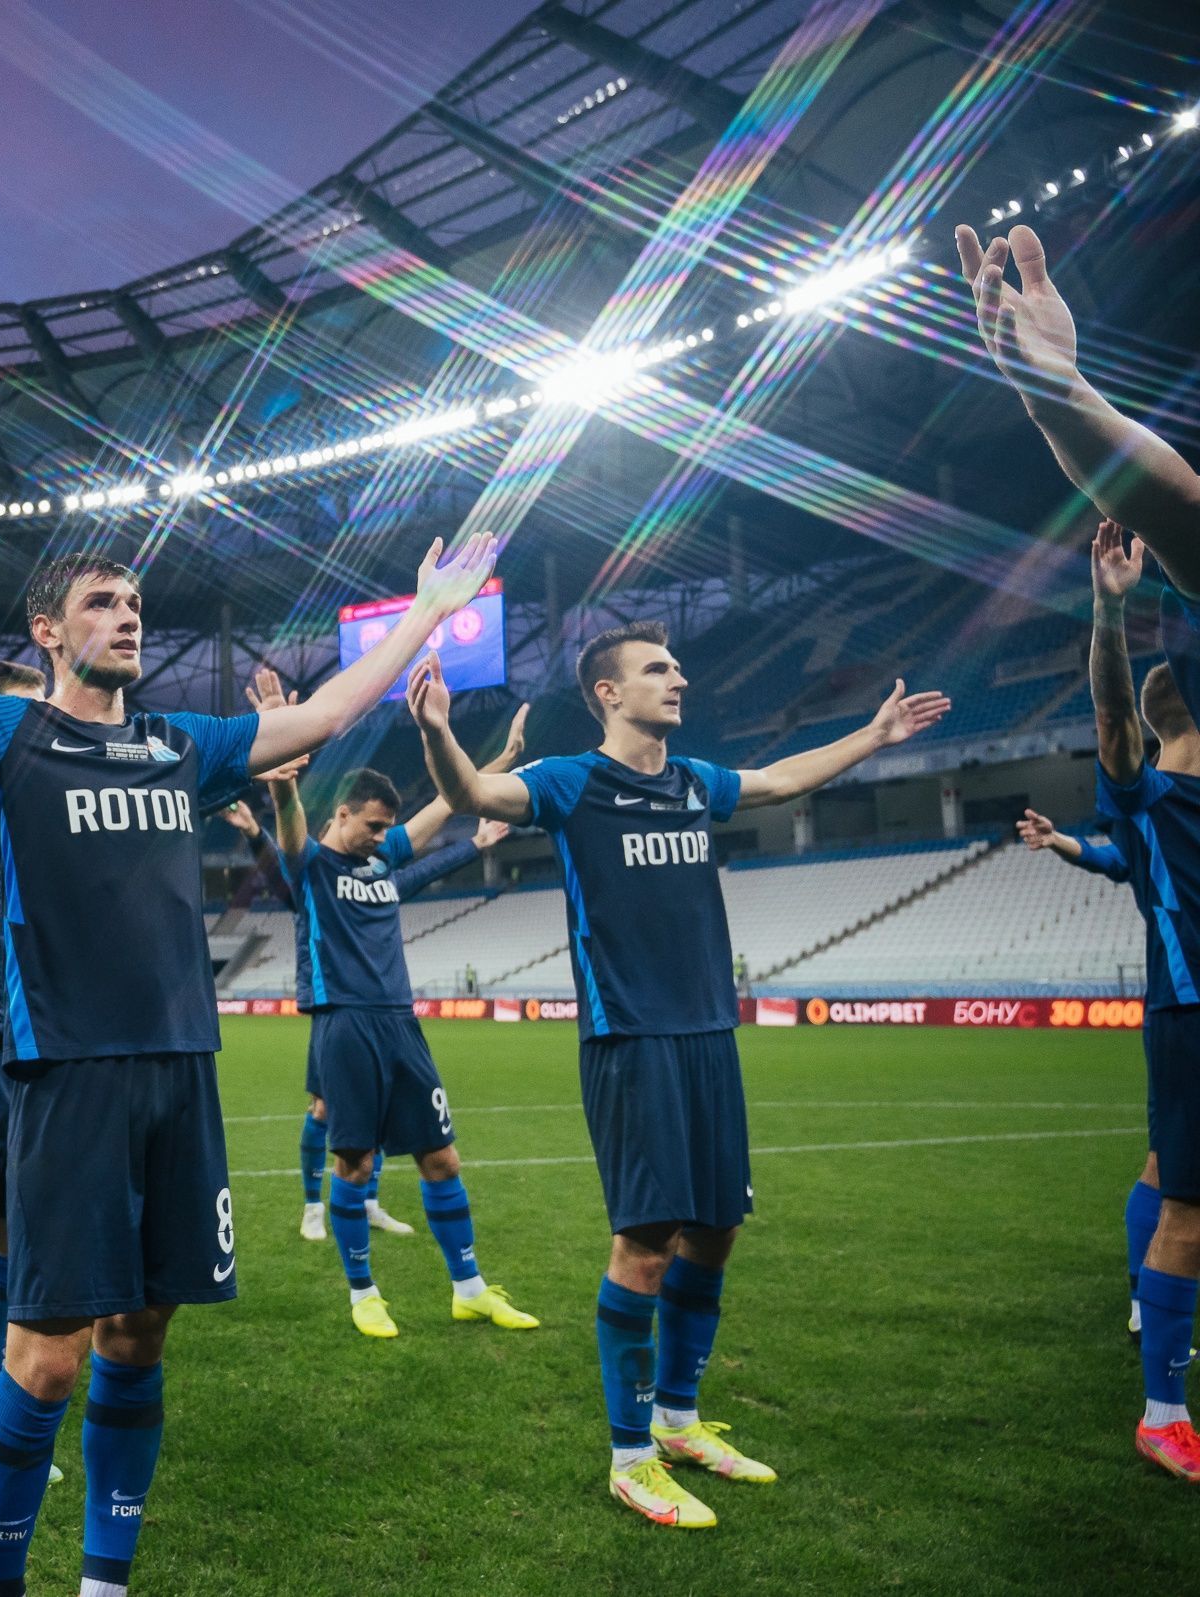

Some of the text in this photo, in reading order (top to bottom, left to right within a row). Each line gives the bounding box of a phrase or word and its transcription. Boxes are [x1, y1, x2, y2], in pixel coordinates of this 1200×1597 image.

[65, 787, 194, 834] ROTOR
[621, 830, 709, 867] ROTOR
[828, 1002, 925, 1024] OLIMPBET
[1049, 1000, 1083, 1026] 30
[216, 1187, 235, 1255] 8
[111, 1504, 144, 1517] FCRV
